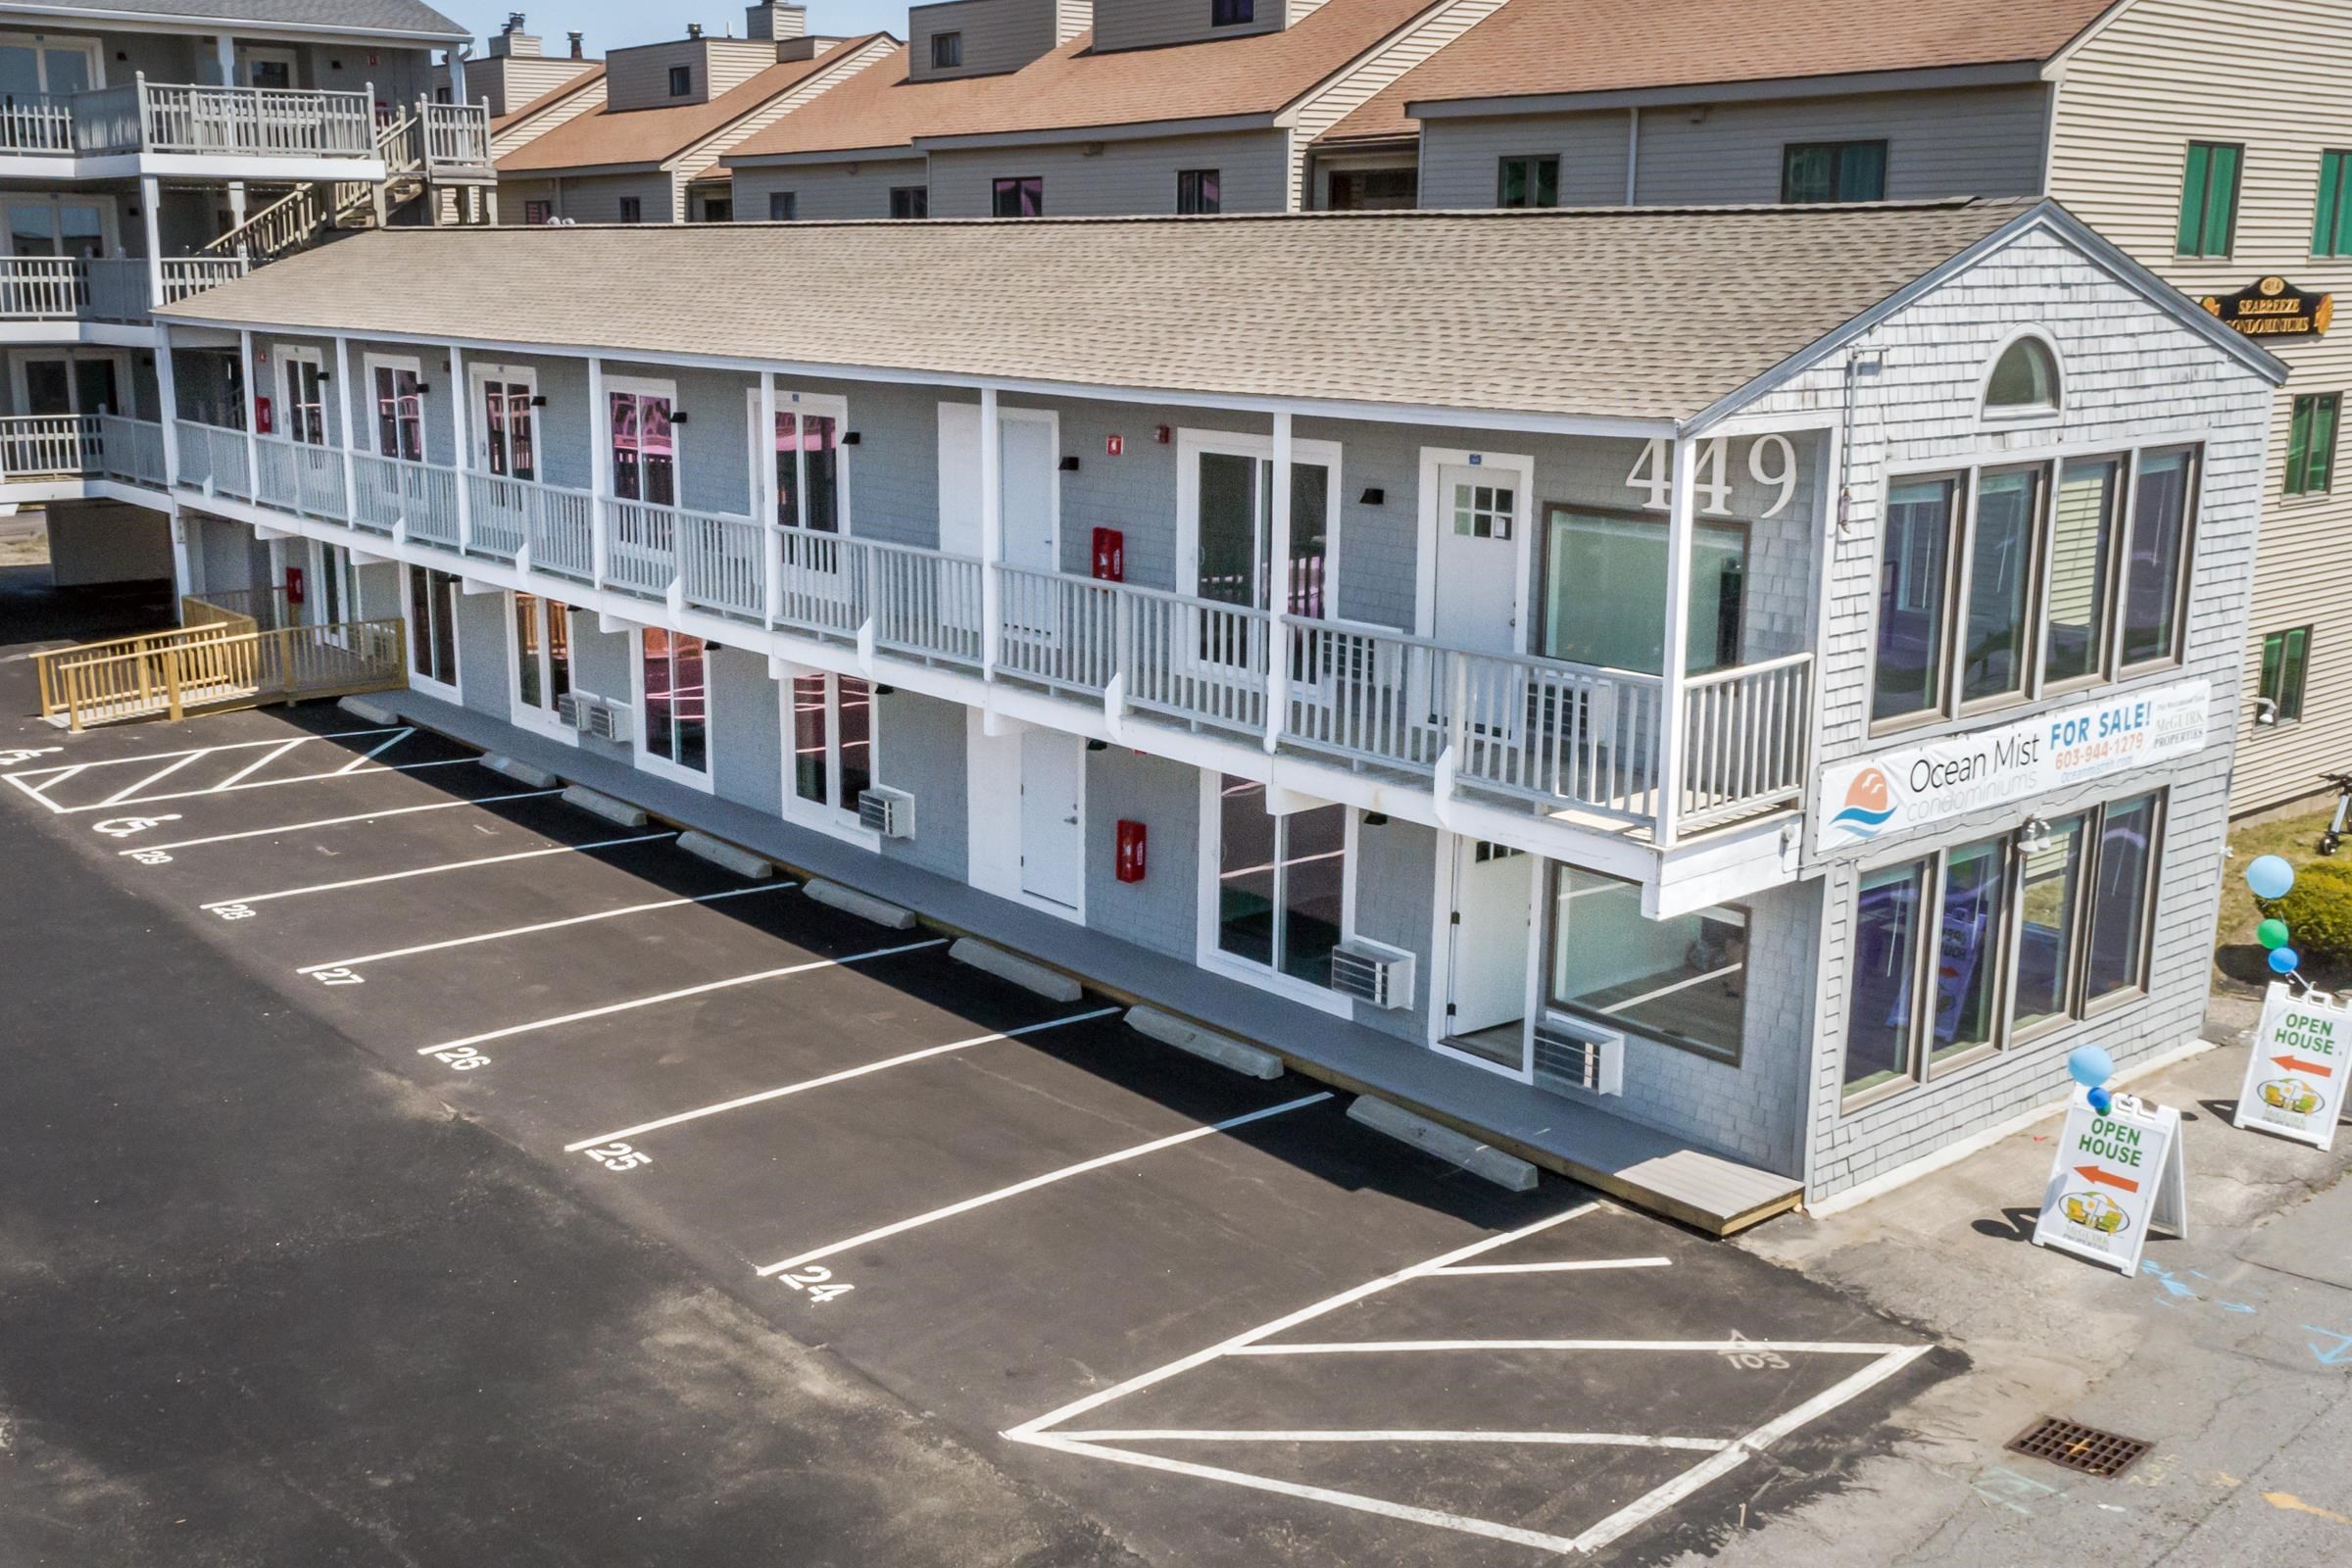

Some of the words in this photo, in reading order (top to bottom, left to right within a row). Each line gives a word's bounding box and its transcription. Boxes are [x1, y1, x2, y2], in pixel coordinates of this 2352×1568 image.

[1625, 434, 1797, 518] 449
[2050, 715, 2089, 750] FOR
[2098, 702, 2152, 736] SALE!
[2154, 727, 2204, 750] PROPERTIES
[1909, 751, 1987, 794] Ocean
[1993, 732, 2040, 768] Mist
[2055, 732, 2144, 770] 603-944-1279
[1906, 767, 2038, 822] condominiums
[131, 850, 174, 864] 29
[212, 904, 257, 920] 28
[312, 966, 366, 986] 27
[2285, 1012, 2333, 1037] OPEN
[2274, 1027, 2335, 1055] HOUSE
[434, 1046, 492, 1071] 26
[2090, 1117, 2142, 1147] OPEN
[585, 1141, 654, 1171] 25
[2078, 1133, 2144, 1167] HOUSE
[778, 1264, 856, 1302] 24
